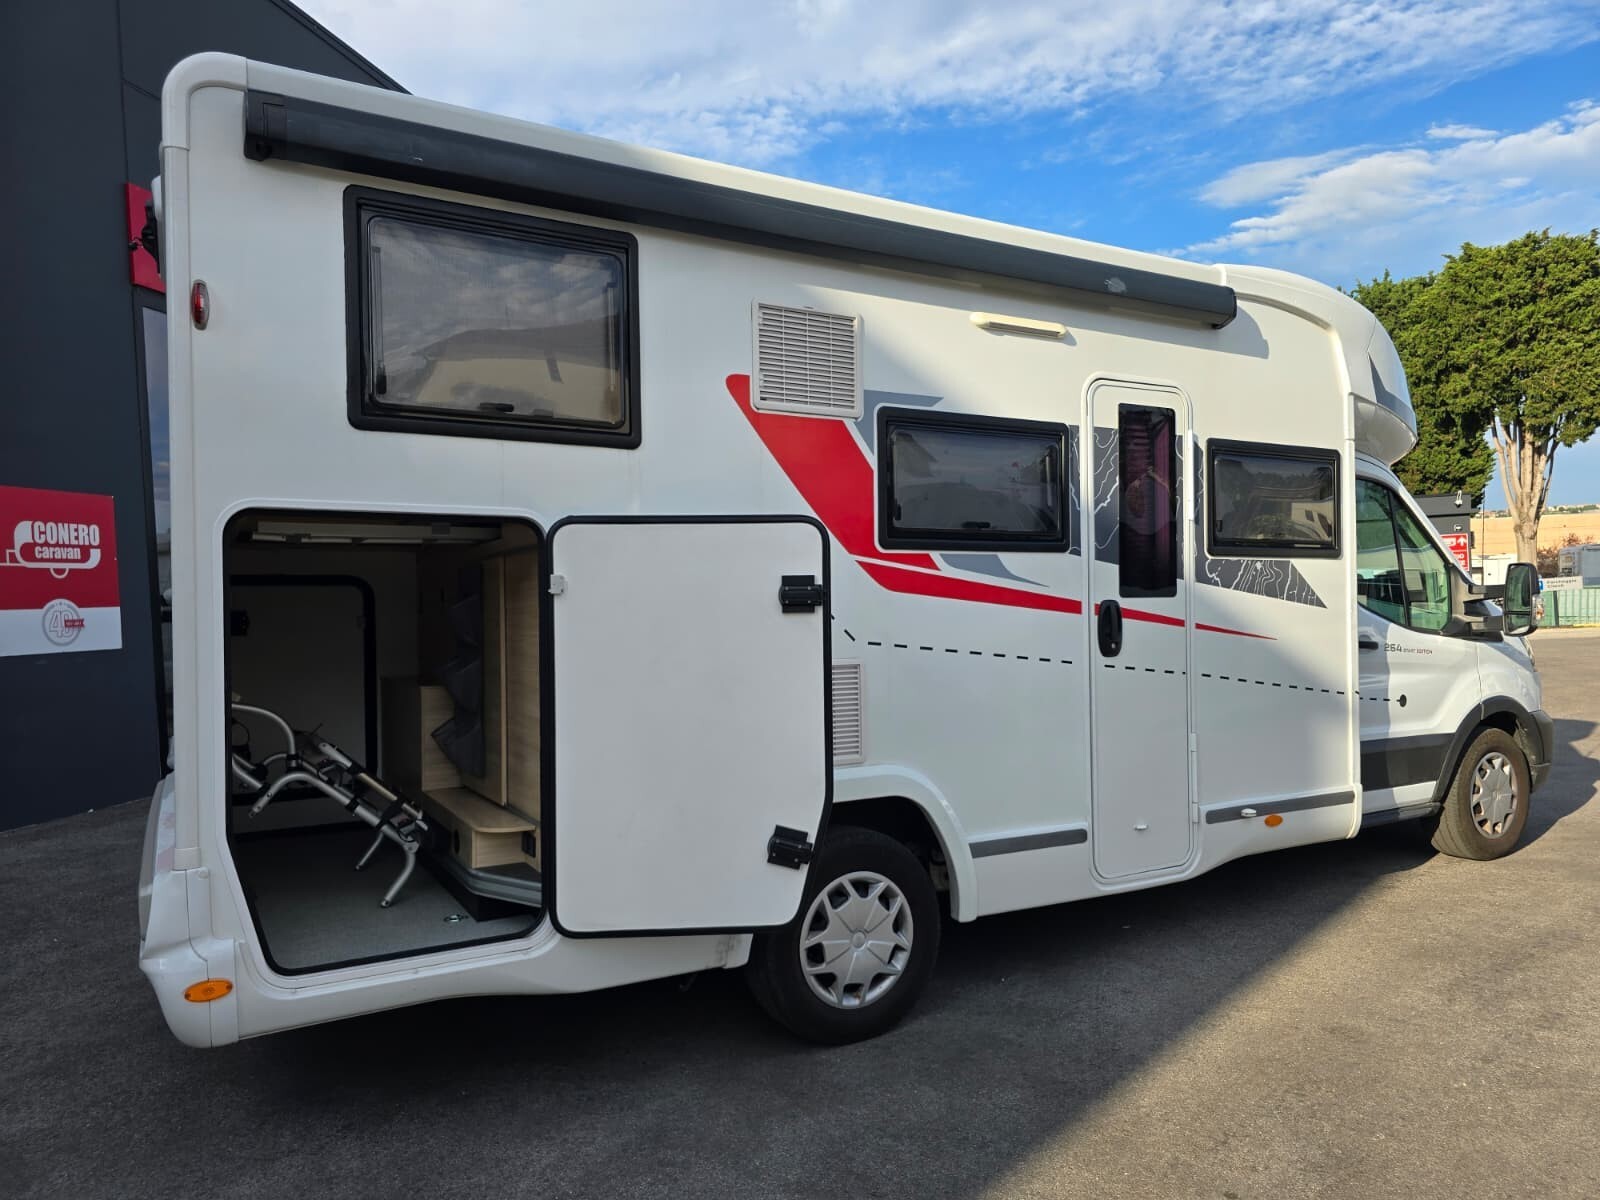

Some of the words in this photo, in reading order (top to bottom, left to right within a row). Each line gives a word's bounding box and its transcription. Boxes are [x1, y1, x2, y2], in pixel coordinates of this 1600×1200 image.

[33, 521, 100, 546] CONERO
[34, 545, 81, 560] caravan
[1384, 643, 1402, 653] 264
